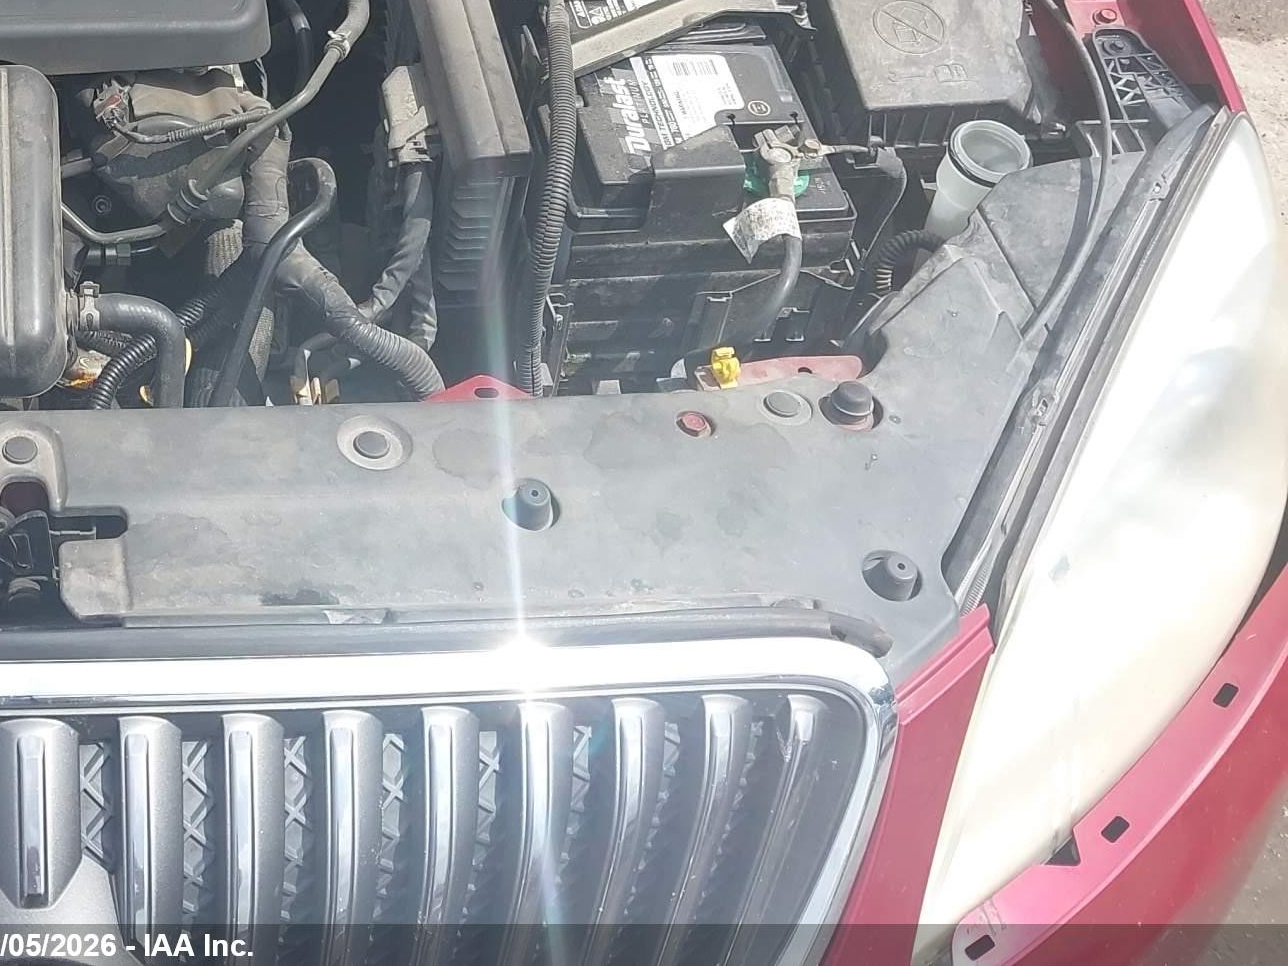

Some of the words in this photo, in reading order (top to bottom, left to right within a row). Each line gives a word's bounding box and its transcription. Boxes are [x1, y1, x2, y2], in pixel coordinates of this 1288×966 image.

[603, 76, 652, 154] Duralast
[628, 79, 650, 125] PLATINUM
[641, 80, 666, 130] TECHNOLOGY
